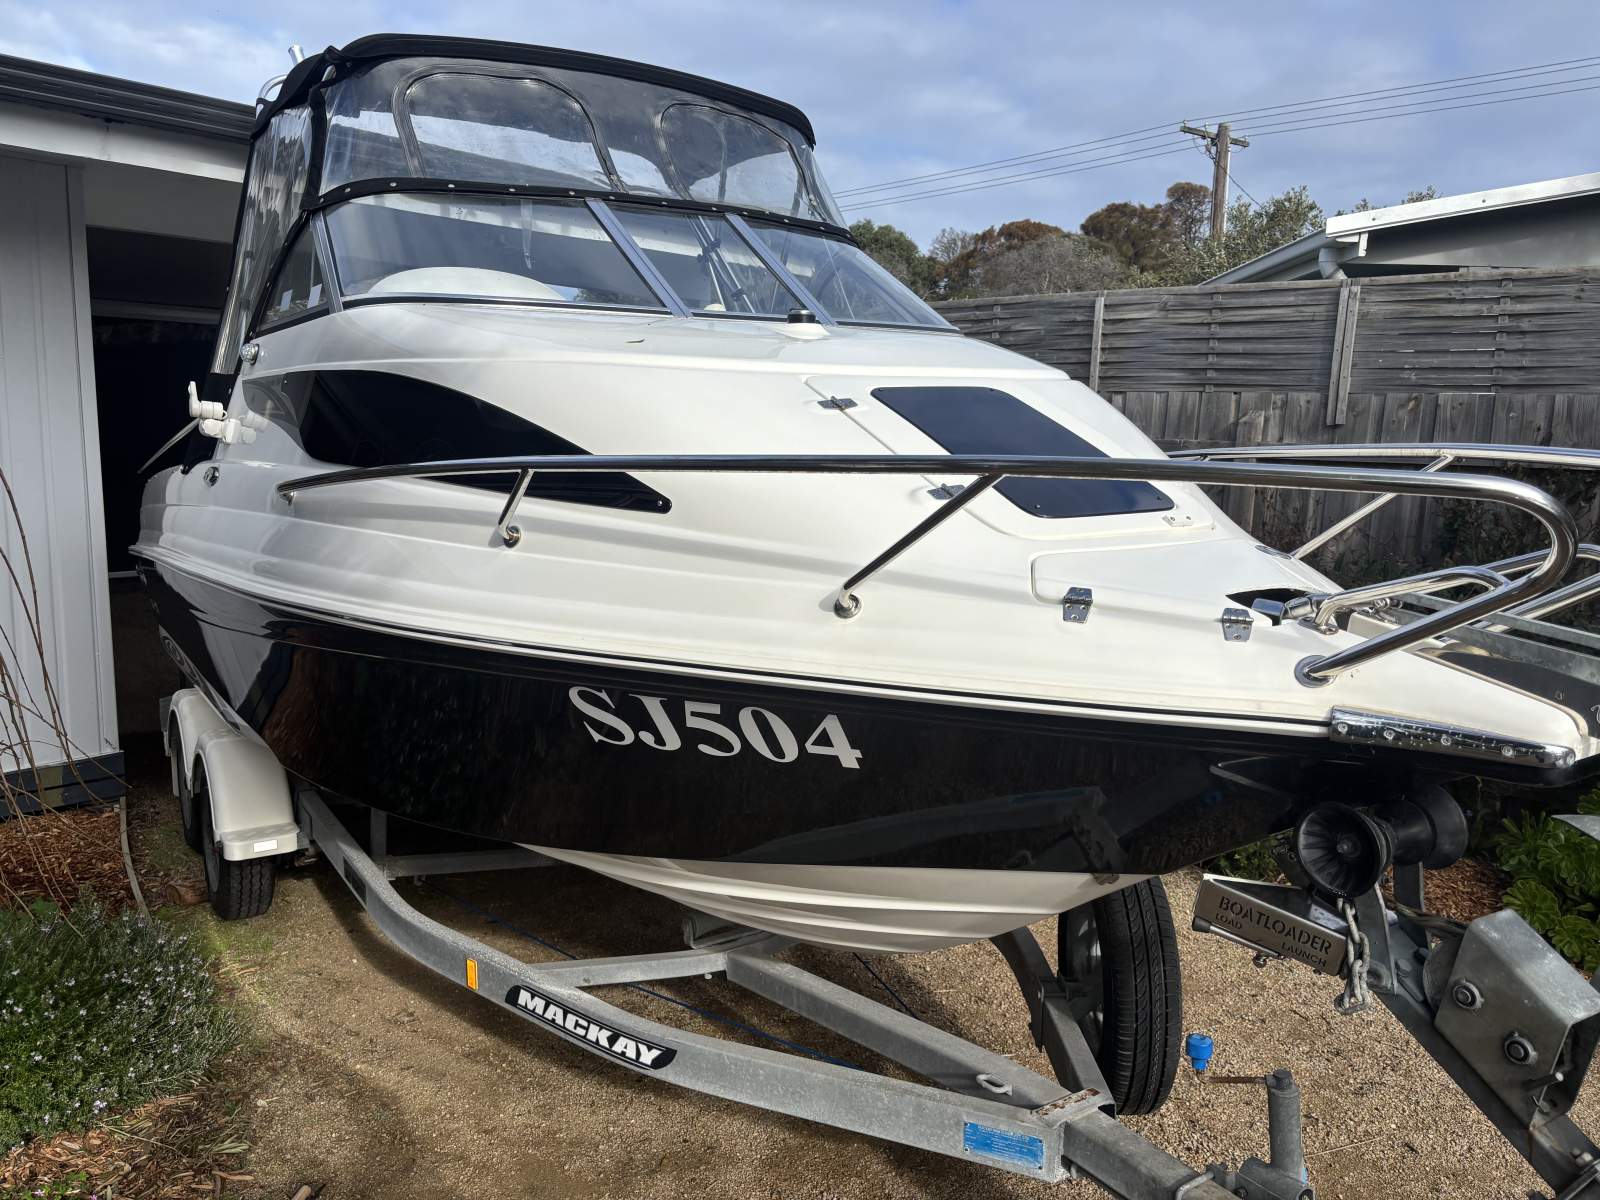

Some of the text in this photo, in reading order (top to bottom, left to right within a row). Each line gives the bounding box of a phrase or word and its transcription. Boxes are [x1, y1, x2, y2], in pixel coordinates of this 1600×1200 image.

[568, 686, 863, 769] SJ504
[1215, 912, 1242, 930] LOAD
[1219, 895, 1332, 955] BOATLOADER
[1281, 942, 1327, 967] LAUNCH
[517, 988, 663, 1067] MACKAY
